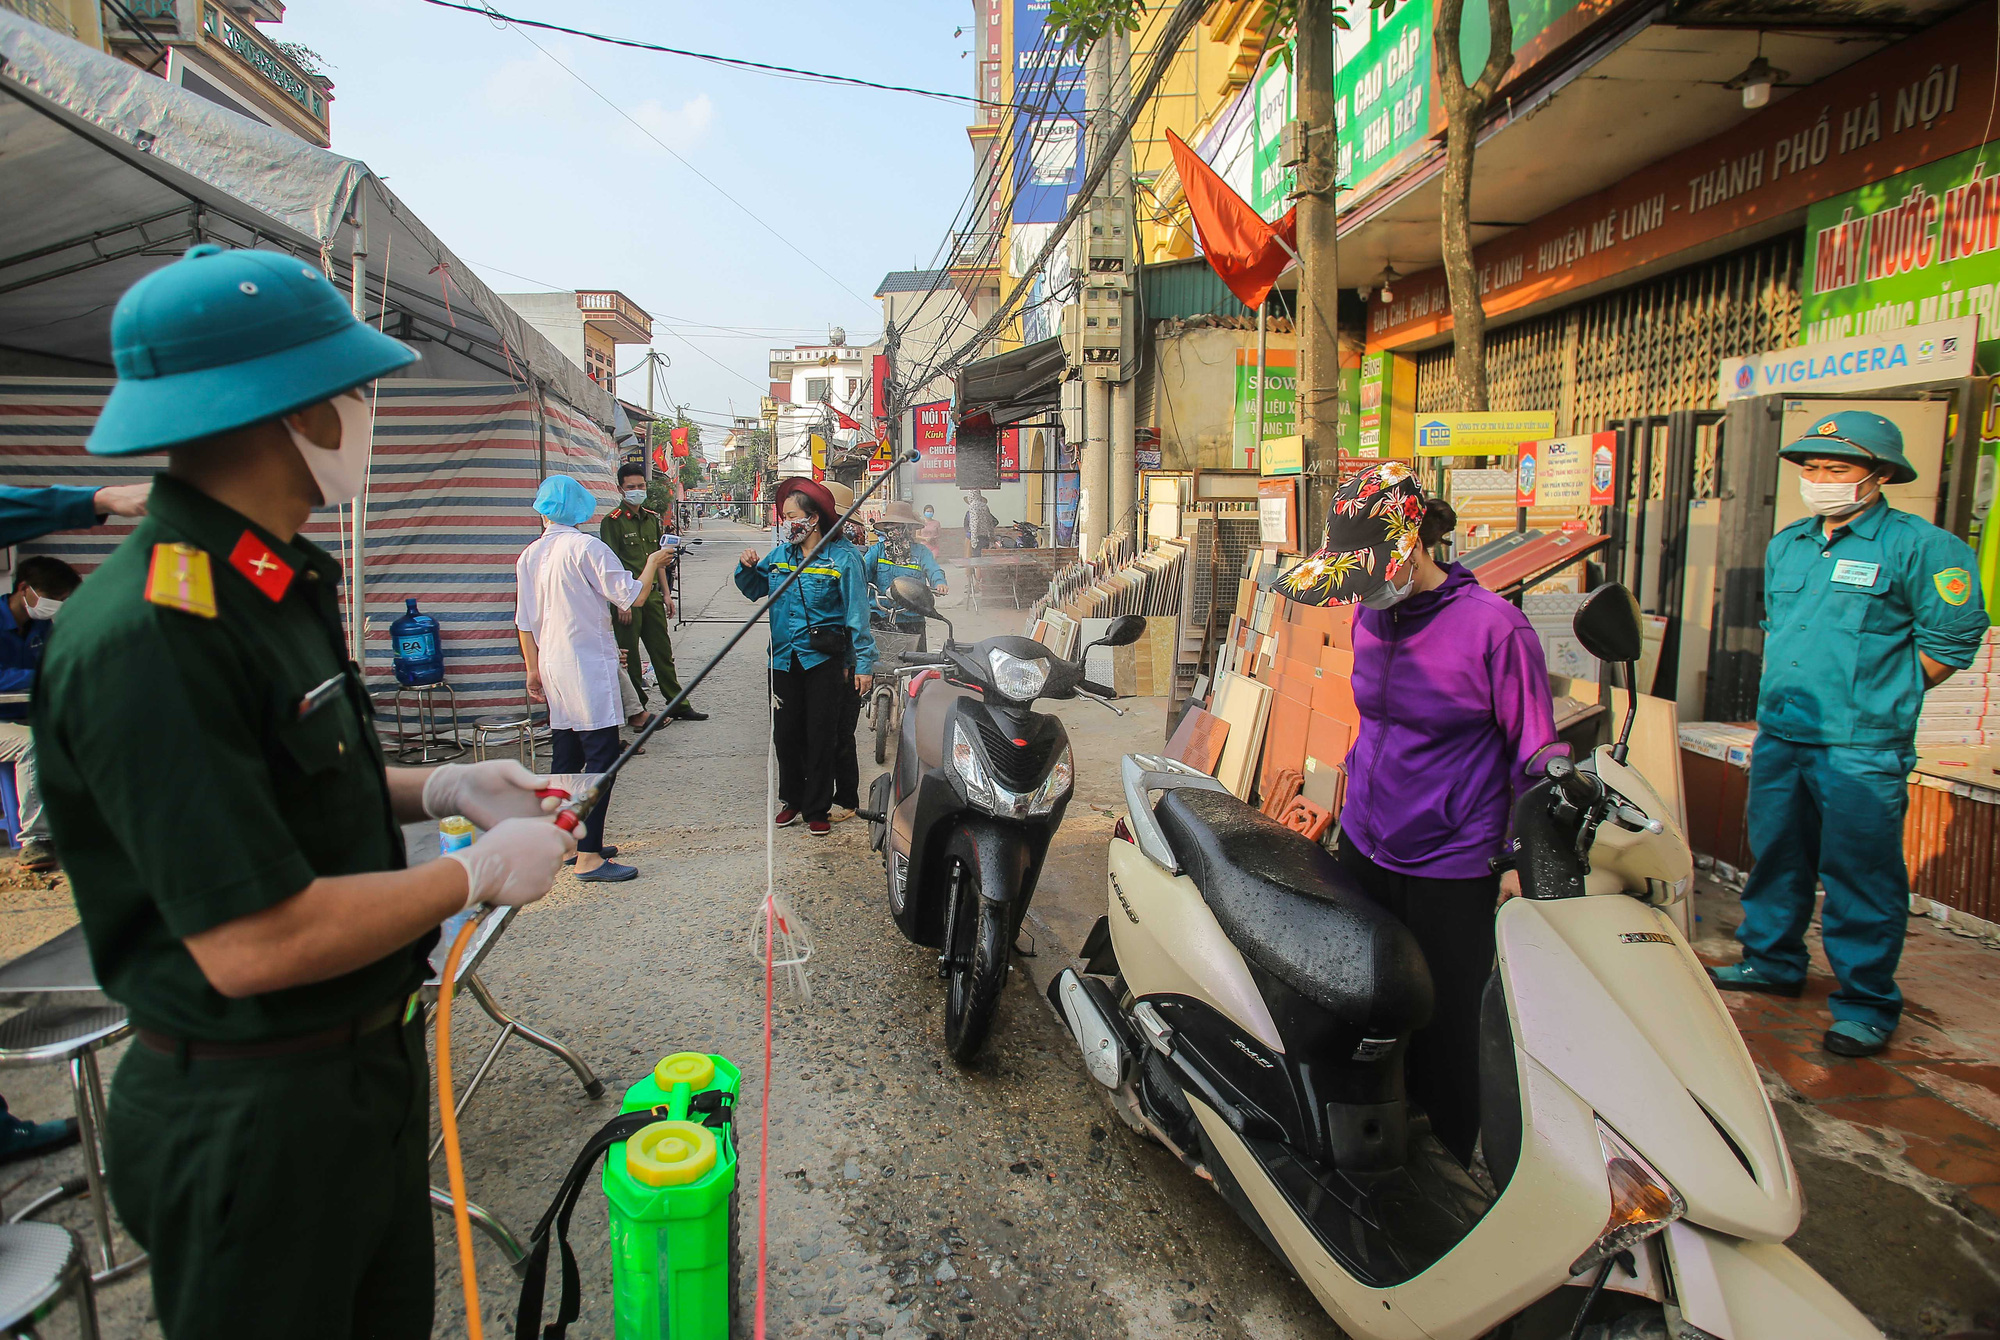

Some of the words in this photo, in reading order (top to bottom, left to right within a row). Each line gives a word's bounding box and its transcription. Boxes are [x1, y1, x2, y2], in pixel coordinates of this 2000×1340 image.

[1354, 62, 1383, 118] CAO
[1387, 24, 1421, 89] CẤP
[1364, 106, 1390, 163] NHÀ
[1394, 78, 1423, 140] BẾP
[1410, 284, 1429, 320] PHỐ
[1494, 254, 1524, 290] LINH
[1537, 227, 1587, 275] HUYỆN
[1590, 209, 1617, 254] MÊ
[1621, 193, 1665, 241] LINH
[1688, 150, 1764, 214] THÀNH
[1772, 105, 1831, 181] PHỐ
[1839, 92, 1880, 155] HÀ
[1893, 63, 1960, 134] NỘI
[1813, 206, 1869, 296] MÁY
[1865, 183, 1940, 282] NƯỚC
[1765, 343, 1909, 386] VIGLACERA
[1548, 443, 1566, 454] NPG
